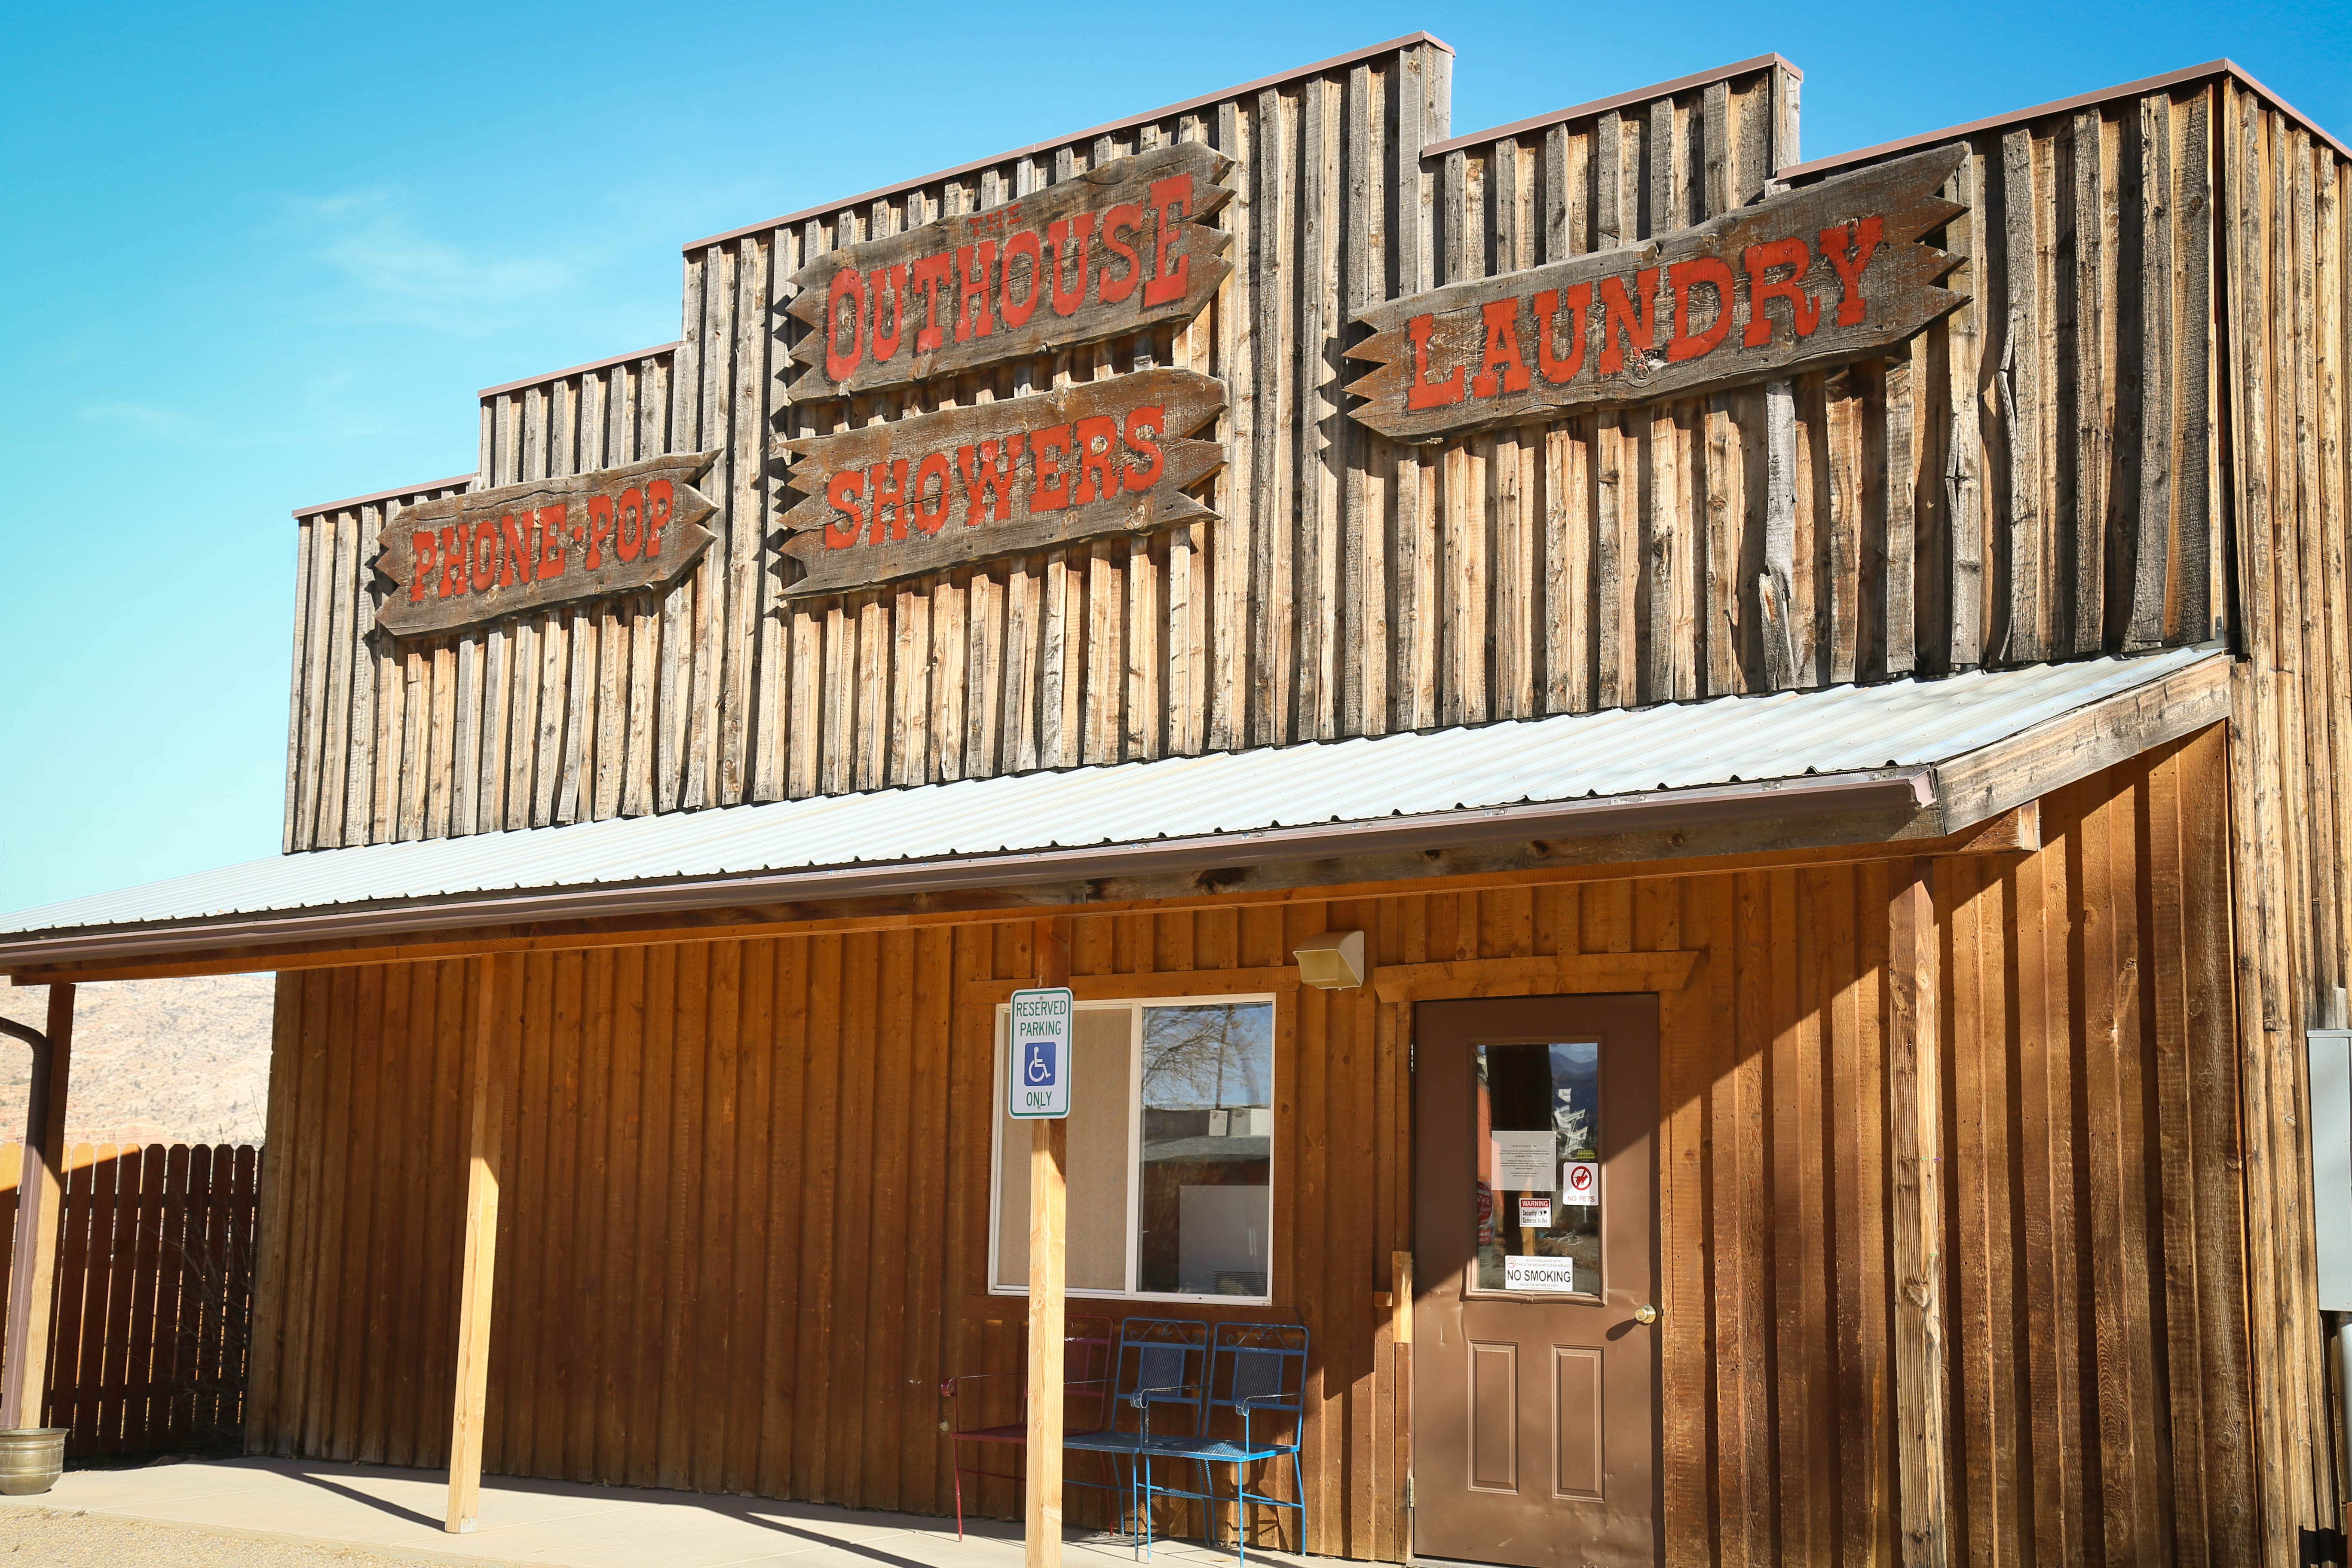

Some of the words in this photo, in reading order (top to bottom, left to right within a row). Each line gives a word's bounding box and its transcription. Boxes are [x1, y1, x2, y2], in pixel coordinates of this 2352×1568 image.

[969, 202, 1022, 237] THE
[826, 172, 1192, 383] OUTHOUSE
[1406, 214, 1883, 411] LAUNDRY
[825, 402, 1165, 551] SHOWERS
[1016, 1000, 1066, 1017] RESERVED
[1020, 1020, 1062, 1036] PARKING
[1026, 1091, 1052, 1106] ONLY
[1507, 1270, 1521, 1281] NO
[1524, 1270, 1571, 1283] SMOKING
